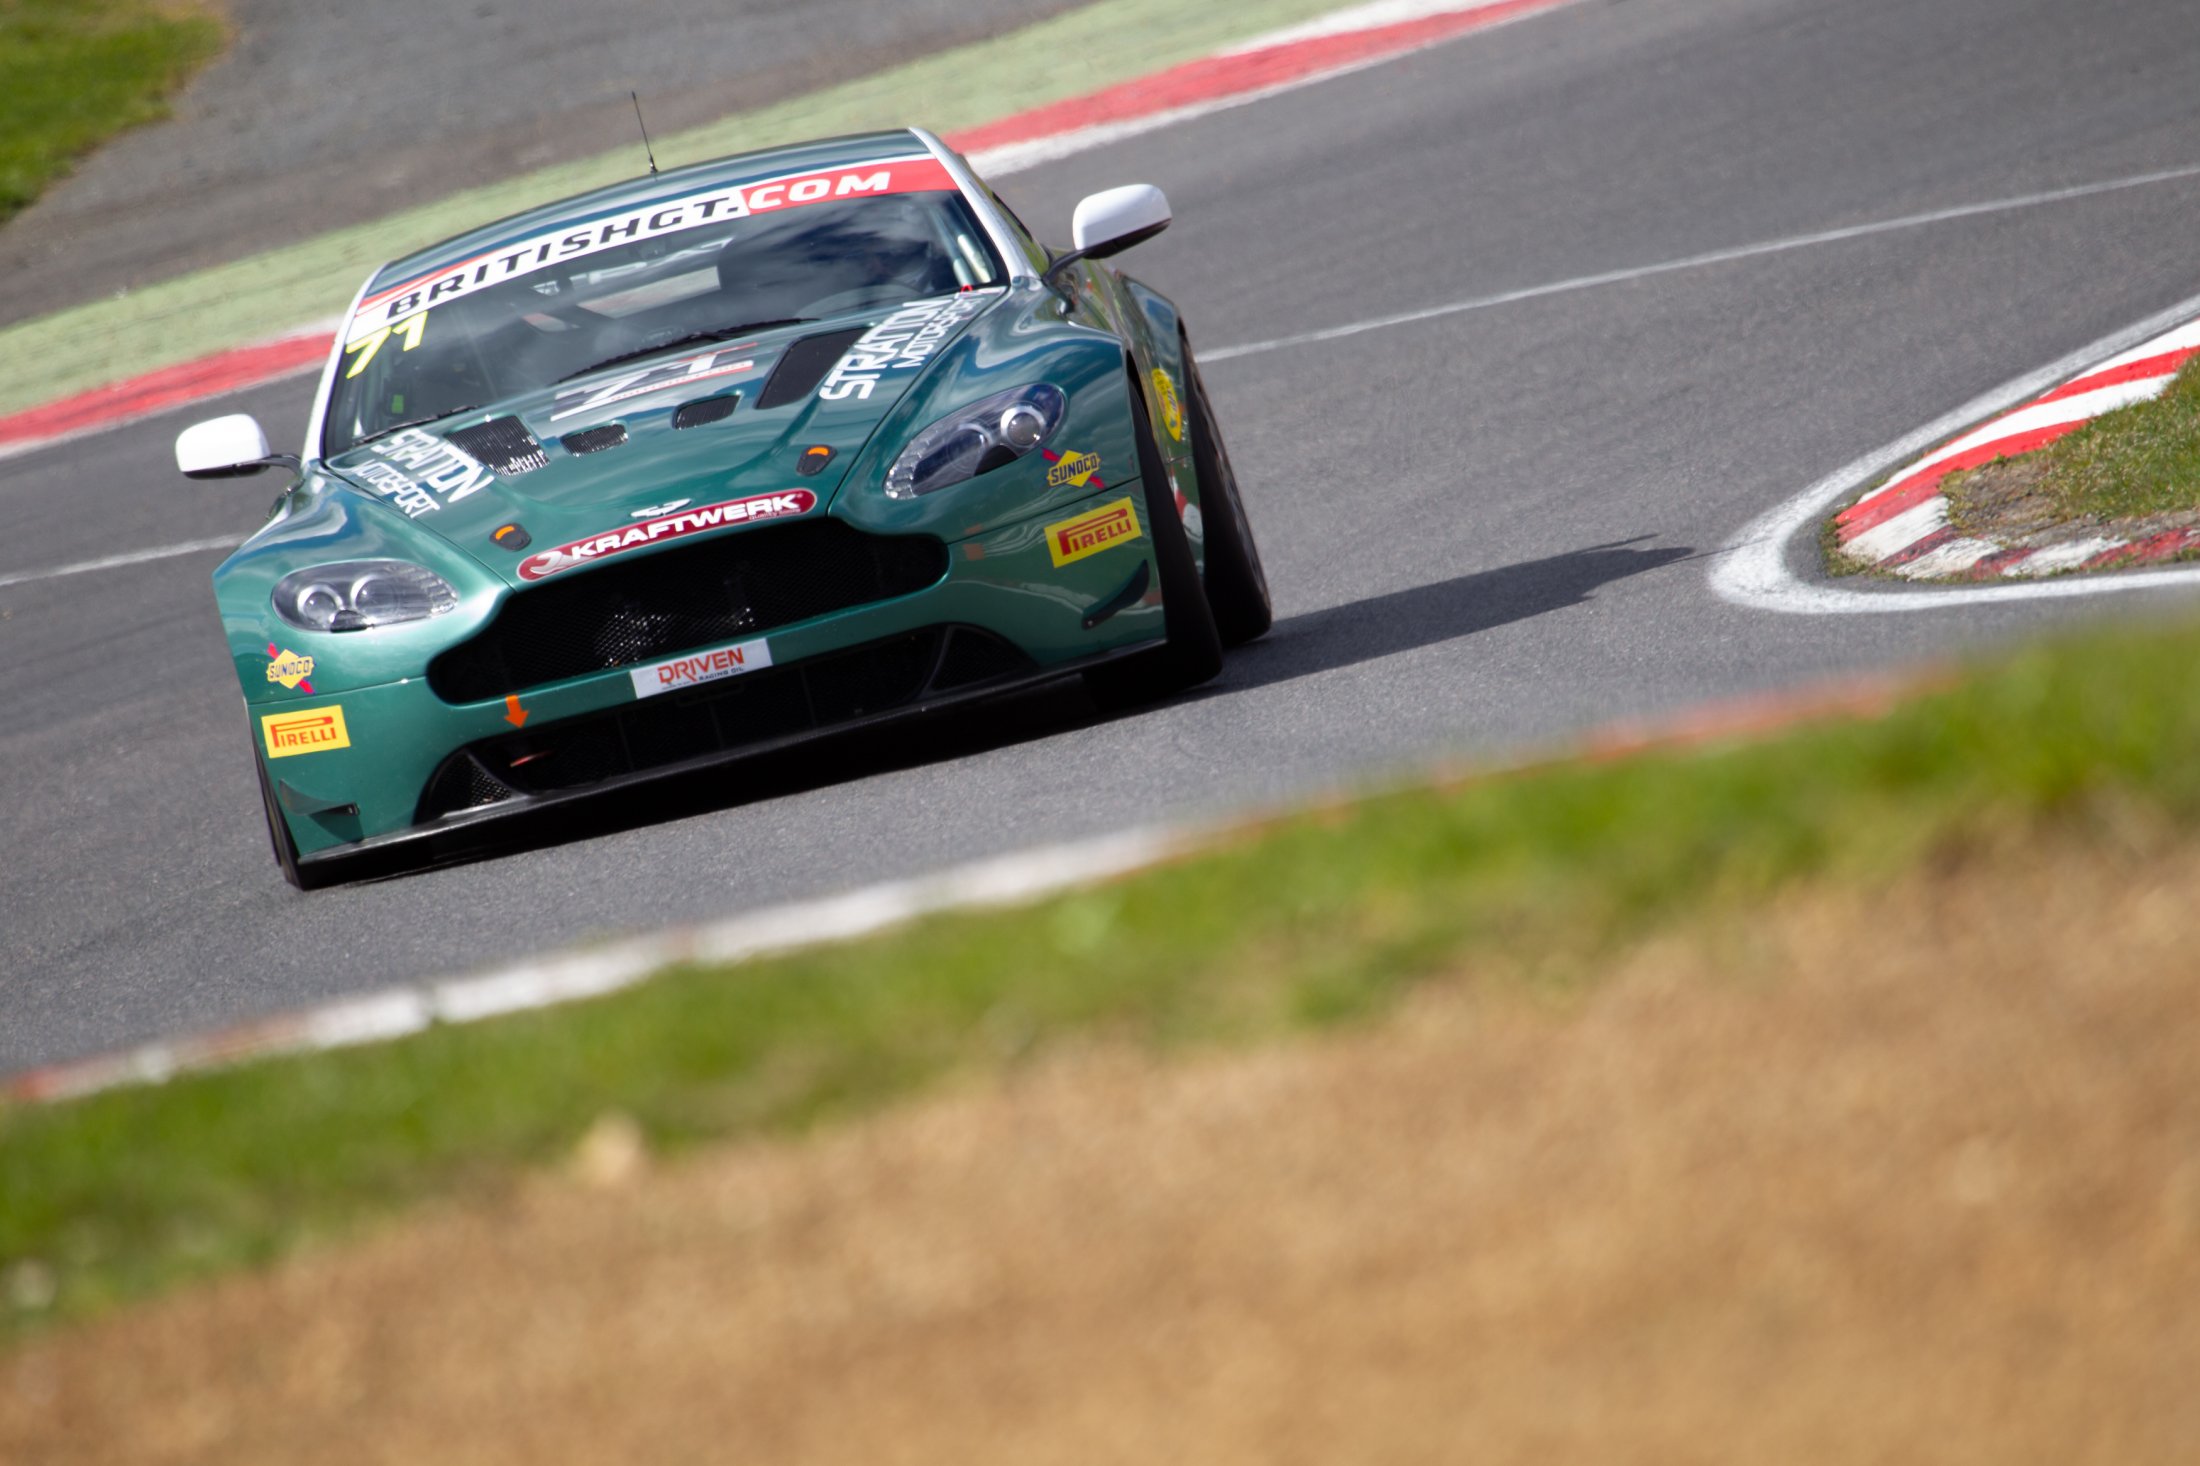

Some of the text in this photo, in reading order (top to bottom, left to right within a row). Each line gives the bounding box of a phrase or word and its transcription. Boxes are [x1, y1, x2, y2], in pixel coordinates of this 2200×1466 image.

[386, 171, 891, 320] BRITISHGT.COM
[345, 310, 428, 379] 71
[819, 299, 953, 400] STRATTON
[370, 428, 495, 503] STRATTON
[1050, 455, 1099, 484] SUNOCO
[571, 493, 800, 561] KRAFTWERK
[1057, 508, 1132, 557] PIRELLI
[269, 660, 310, 679] SUNOCO
[657, 647, 745, 683] DRIVEN
[270, 716, 337, 748] PIRELLI
